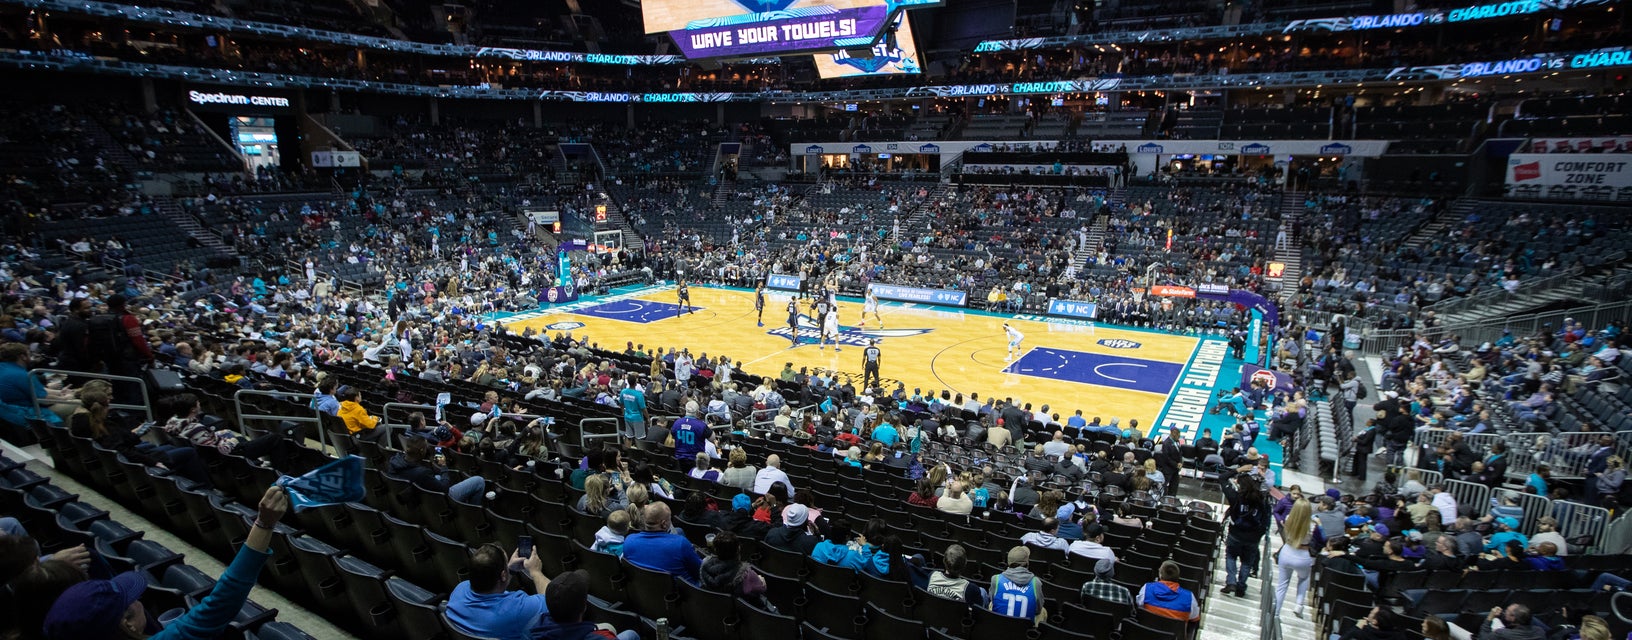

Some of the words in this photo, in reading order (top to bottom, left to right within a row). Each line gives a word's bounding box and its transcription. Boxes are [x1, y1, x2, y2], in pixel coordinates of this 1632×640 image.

[1352, 13, 1424, 30] ORLANDO
[1428, 13, 1443, 24] VS
[1447, 0, 1541, 22] CHARLOTTE
[691, 31, 732, 49] WAVE
[738, 26, 778, 45] YOUR
[781, 19, 856, 41] TOWELS!
[974, 40, 1001, 52] OTTE
[526, 51, 571, 61] ORLANDO
[586, 53, 638, 65] CHARLOTTE
[1460, 58, 1542, 77] ORLANDO
[1548, 58, 1564, 69] VS
[951, 84, 996, 95] ORLANDO
[1013, 81, 1072, 93] CHARLOTTE
[189, 90, 248, 105] Spectrum
[250, 96, 289, 107] CENTER
[586, 92, 629, 102] ORLANDO
[644, 93, 695, 102] CHARLOTTE
[1554, 162, 1626, 173] COMFORT
[1565, 174, 1606, 184] ZONE
[1076, 305, 1088, 314] NC
[1183, 340, 1228, 388] CHARLOTTE
[676, 430, 694, 444] 40
[1002, 592, 1028, 617] 77
